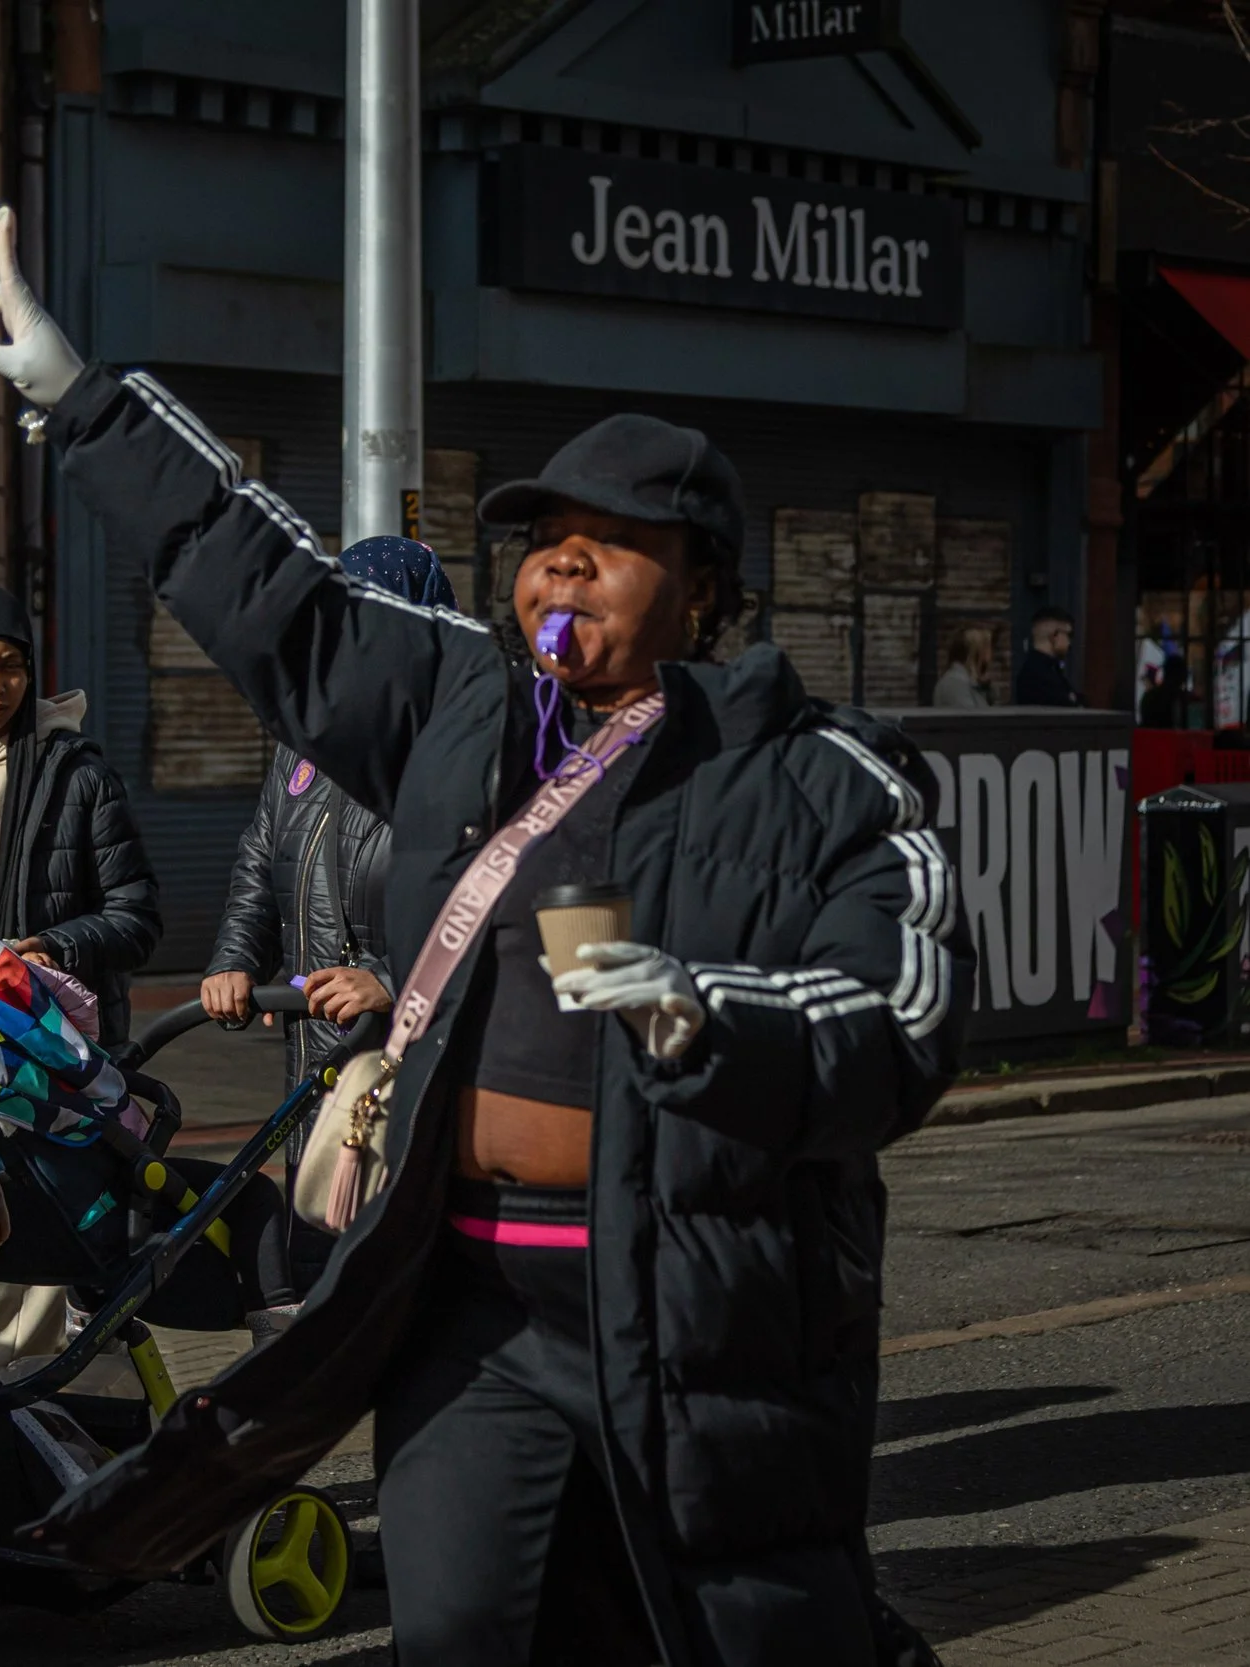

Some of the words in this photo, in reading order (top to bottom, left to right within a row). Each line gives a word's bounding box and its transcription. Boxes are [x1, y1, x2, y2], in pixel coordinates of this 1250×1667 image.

[751, 0, 863, 44] Millar
[571, 176, 733, 278] Jean
[751, 197, 930, 298] Millar
[438, 840, 520, 951] ISLAND
